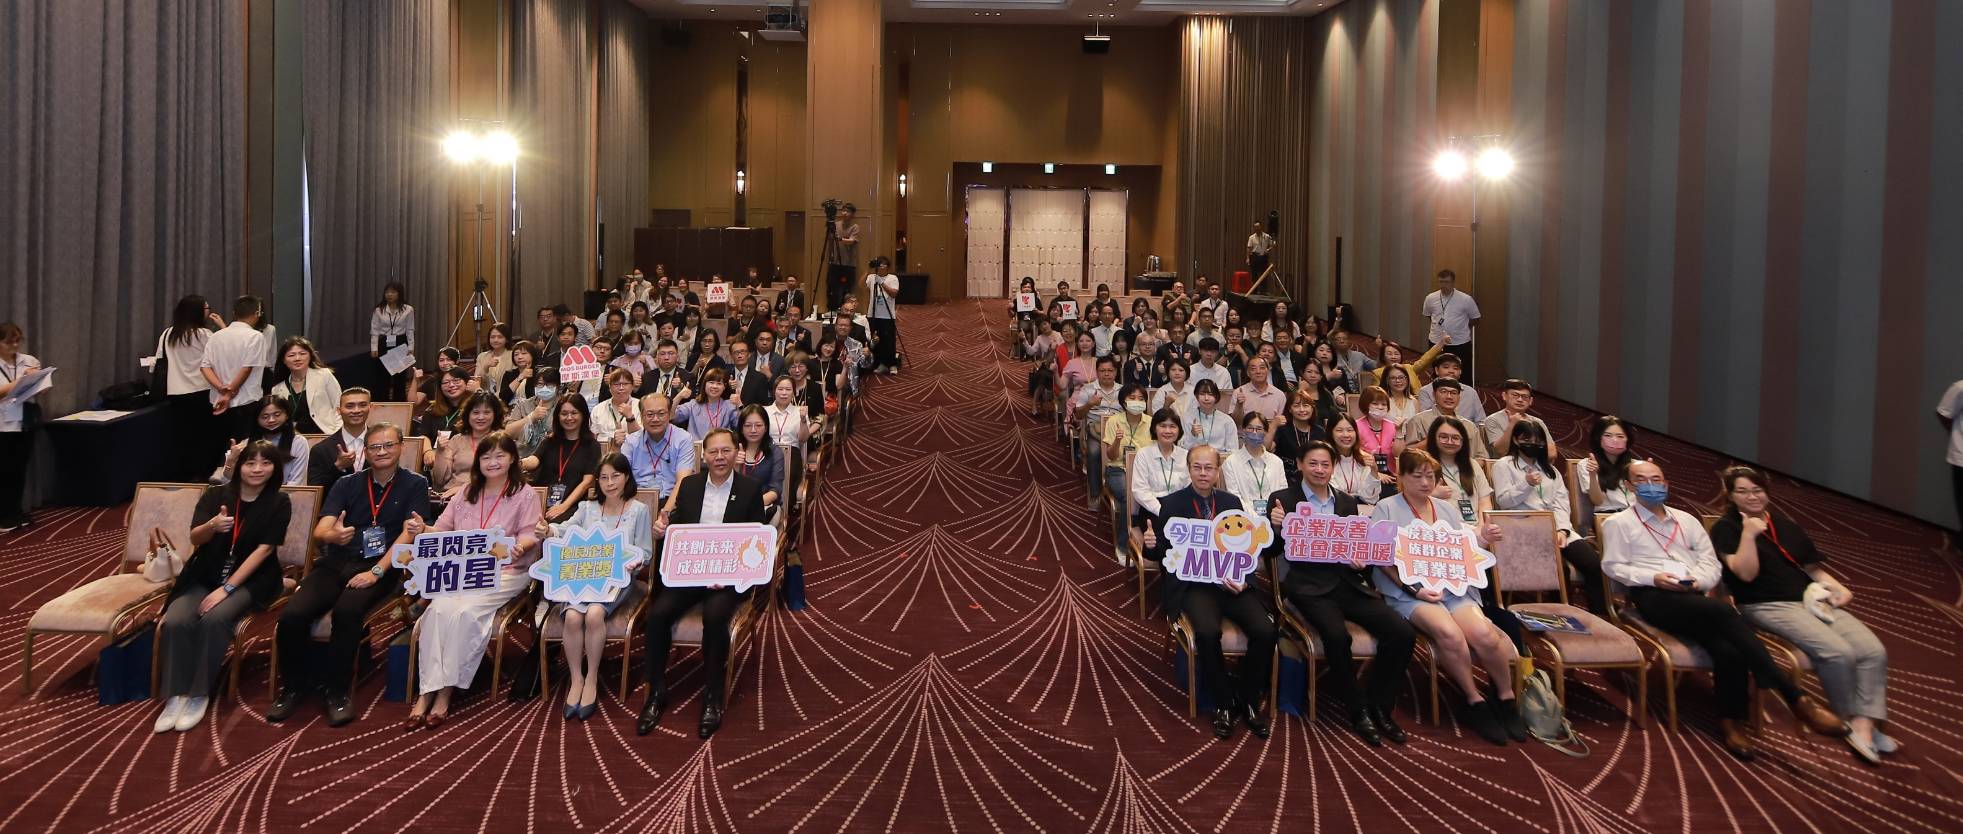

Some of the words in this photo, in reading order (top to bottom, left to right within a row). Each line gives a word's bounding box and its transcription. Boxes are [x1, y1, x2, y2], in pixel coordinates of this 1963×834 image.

[1169, 522, 1210, 545] 今日
[1286, 518, 1368, 539] 企業友善
[417, 534, 487, 558] 最閃亮
[674, 539, 736, 556] 共創未來
[1288, 539, 1392, 561] 社會更溫暖
[1408, 542, 1463, 561] 族群企業
[1182, 548, 1253, 580] MVP
[425, 557, 496, 594] 的星
